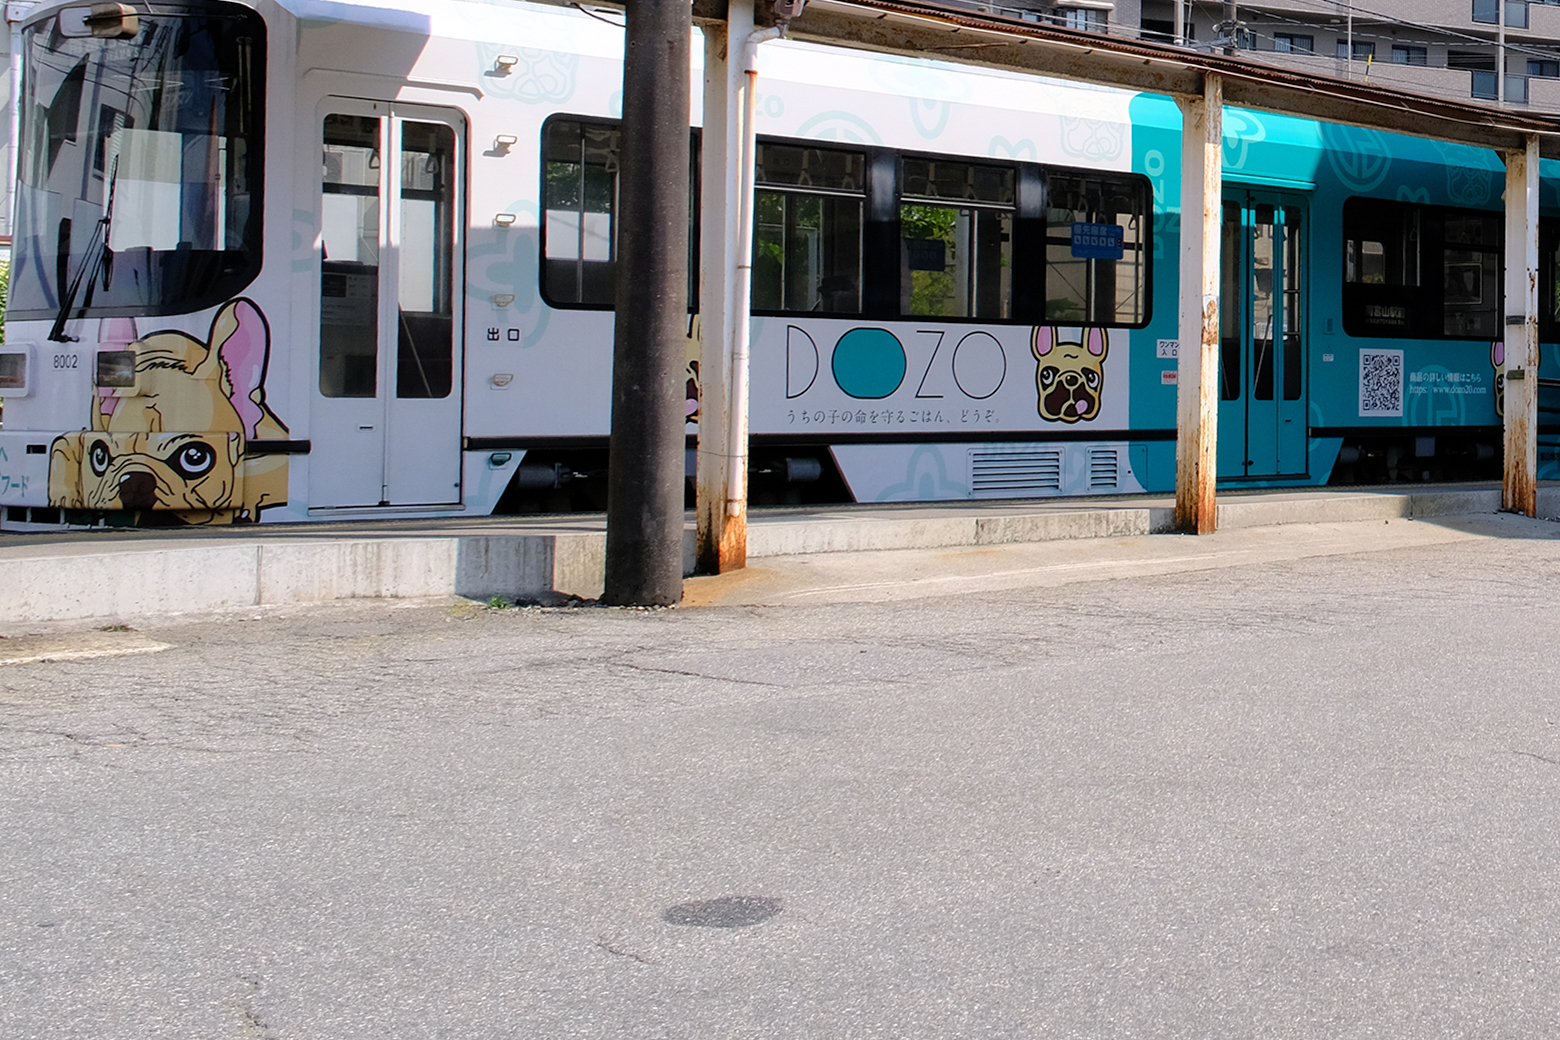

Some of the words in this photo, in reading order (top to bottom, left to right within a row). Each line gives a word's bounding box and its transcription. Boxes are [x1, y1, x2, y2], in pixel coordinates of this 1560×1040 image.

[486, 327, 520, 342] 出口
[1159, 341, 1180, 349] ワンマン
[1161, 349, 1178, 357] 入口
[53, 354, 78, 369] 8002
[785, 324, 1007, 400] DOZO
[1409, 371, 1482, 383] 商品の詳しい情報はこちら
[0, 472, 30, 498] フード
